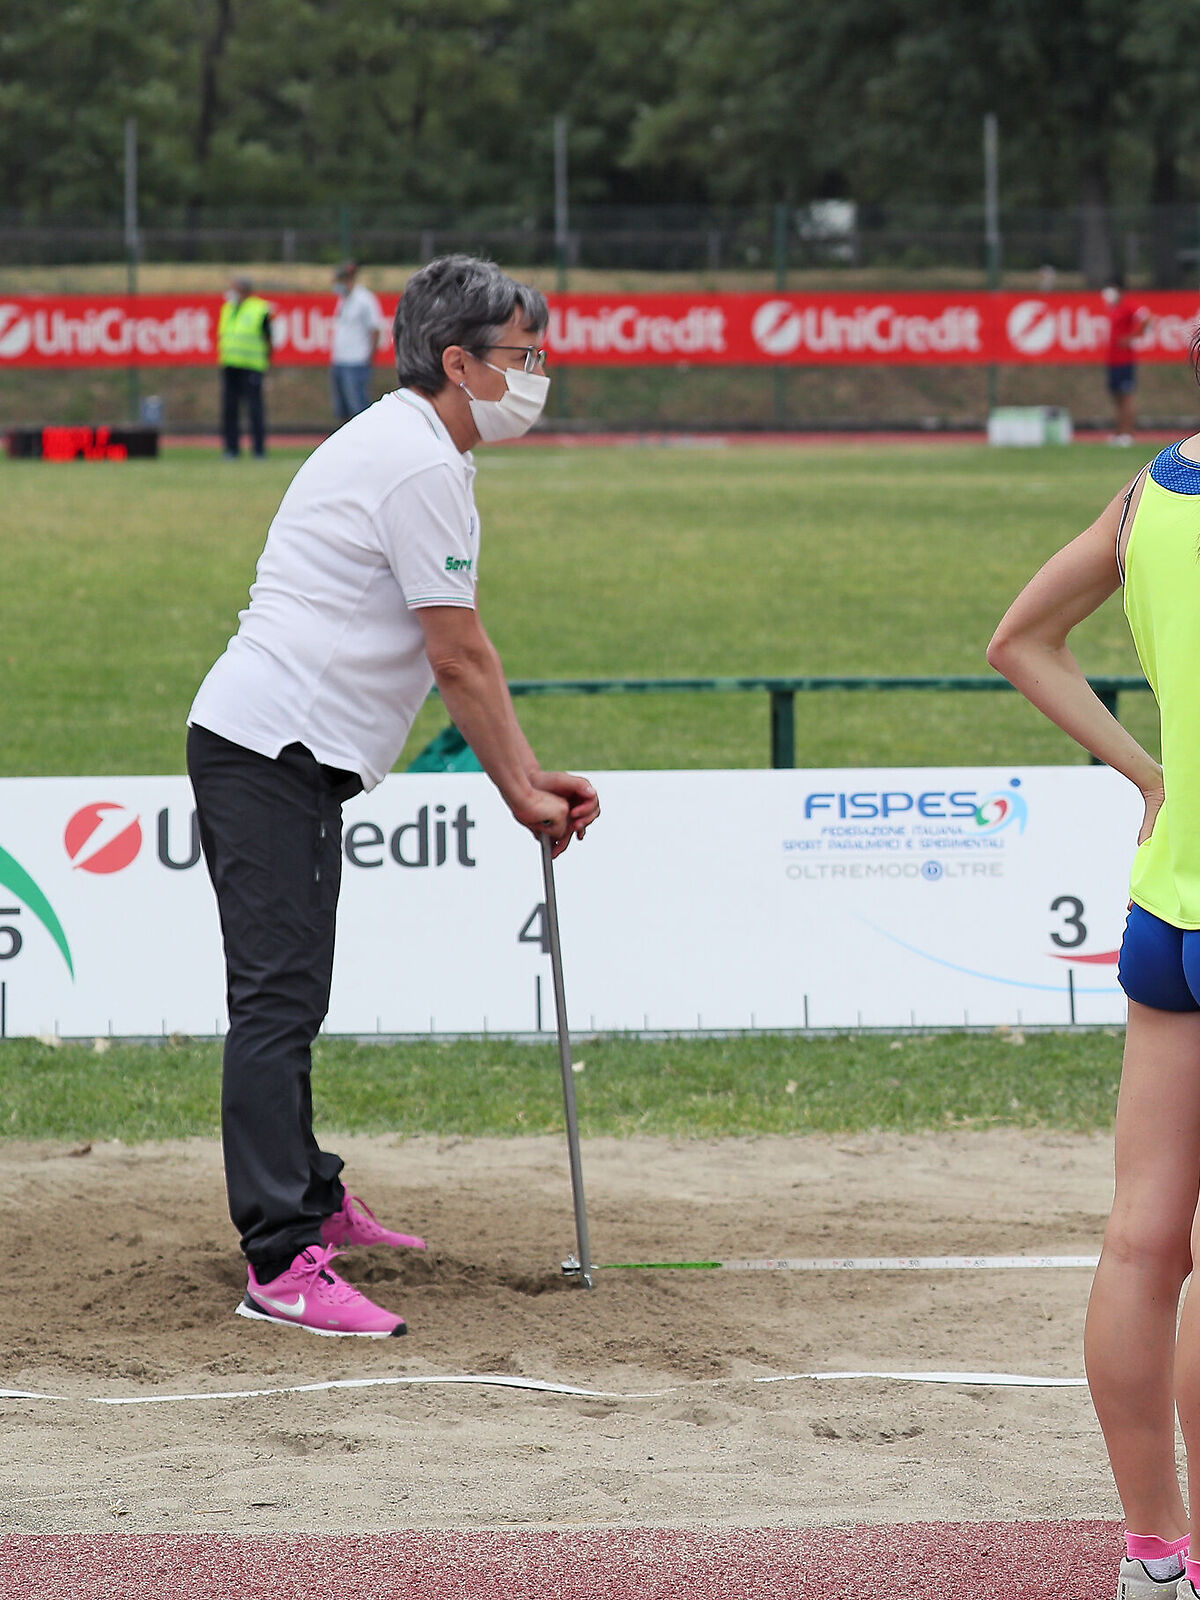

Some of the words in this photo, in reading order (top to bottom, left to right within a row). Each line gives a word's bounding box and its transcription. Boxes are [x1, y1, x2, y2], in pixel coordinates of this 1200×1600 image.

[34, 307, 211, 355] UniCredit
[548, 304, 726, 353] UniCredit
[803, 305, 981, 353] UniCredit
[804, 792, 977, 819] FISPES
[157, 804, 476, 871] Uedit
[518, 902, 551, 953] 4
[1050, 895, 1088, 949] 3
